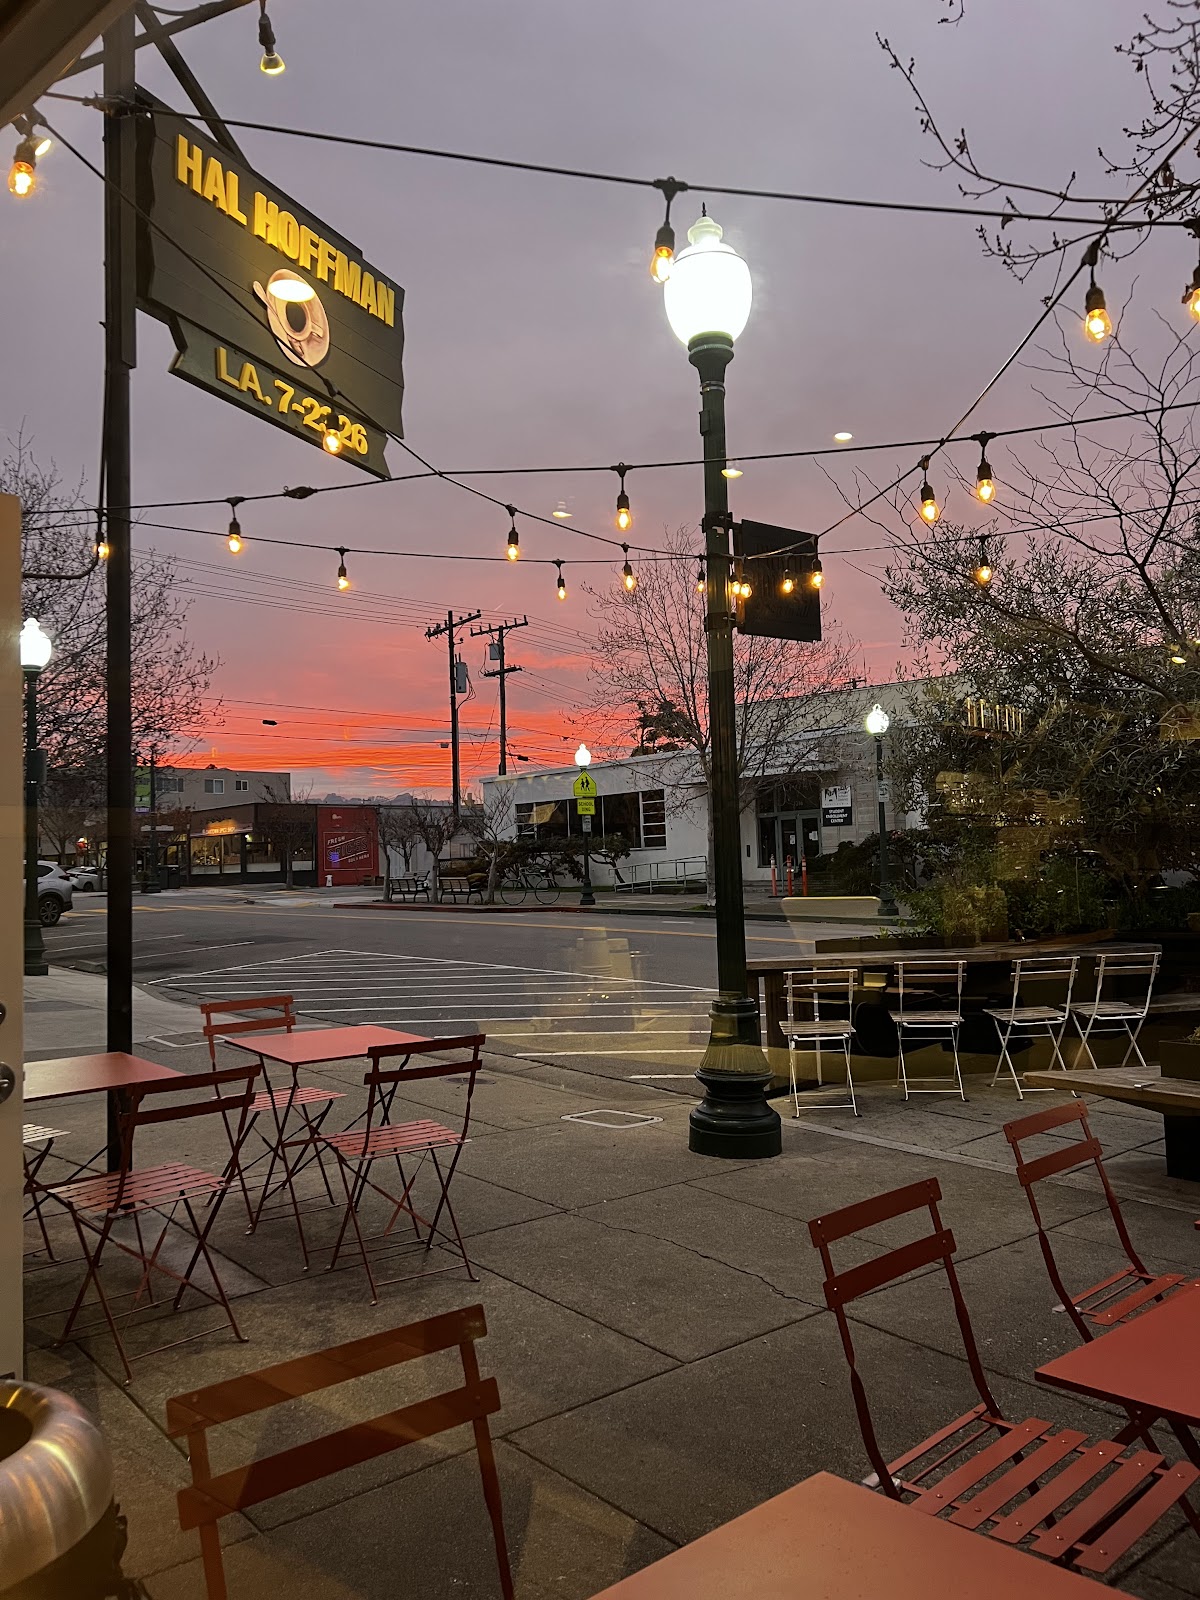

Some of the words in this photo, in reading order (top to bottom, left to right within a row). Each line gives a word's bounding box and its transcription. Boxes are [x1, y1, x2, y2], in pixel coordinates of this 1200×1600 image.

[175, 133, 247, 226] HAL
[253, 191, 395, 328] HOFFMAN
[215, 346, 272, 405] LA.
[327, 836, 345, 845] FRESH
